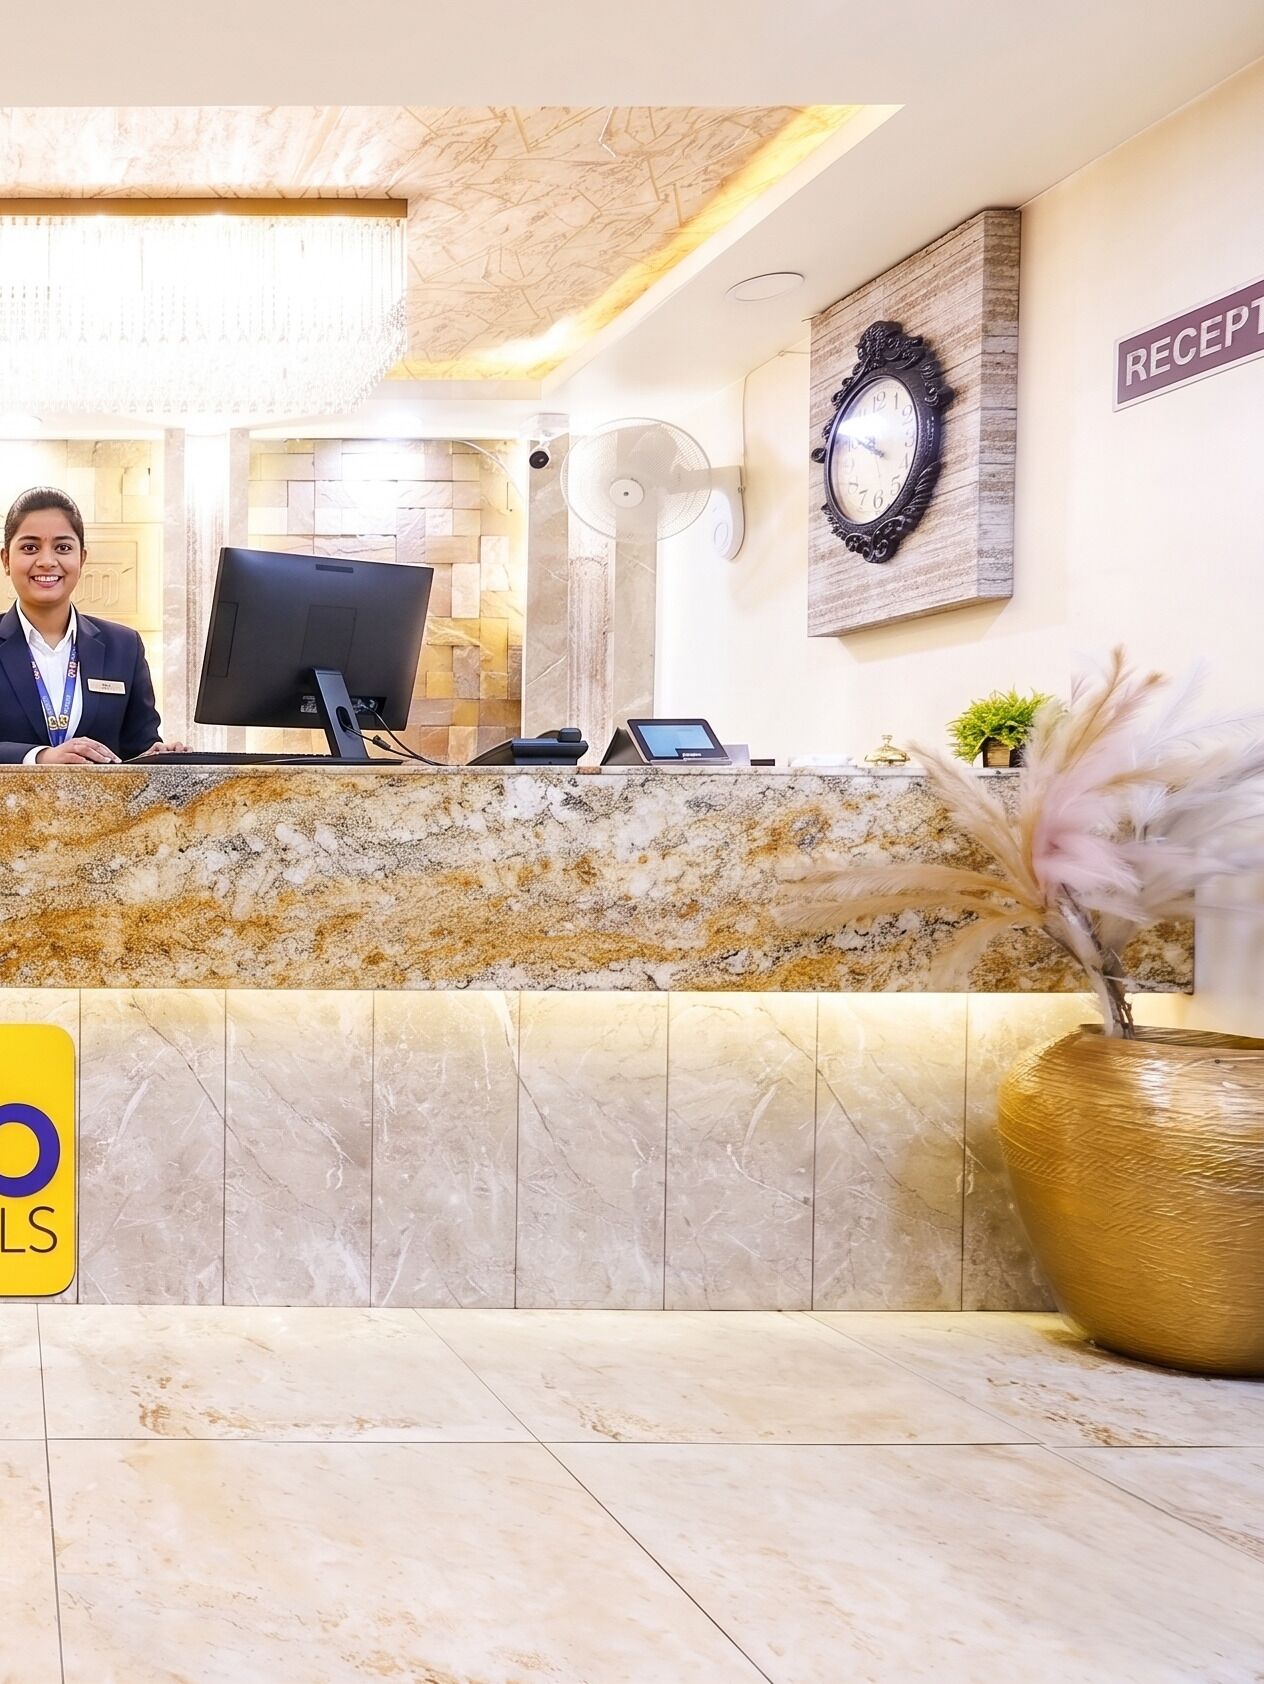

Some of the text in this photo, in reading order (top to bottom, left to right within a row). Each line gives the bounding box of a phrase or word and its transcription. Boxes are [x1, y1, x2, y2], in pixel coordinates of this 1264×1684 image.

[1126, 296, 1264, 386] RECEPT
[872, 391, 886, 413] 12
[901, 404, 914, 426] 2
[904, 428, 915, 448] 3
[898, 452, 909, 470] 4
[890, 474, 902, 497] 5
[858, 488, 869, 506] 7
[872, 488, 884, 510] 6
